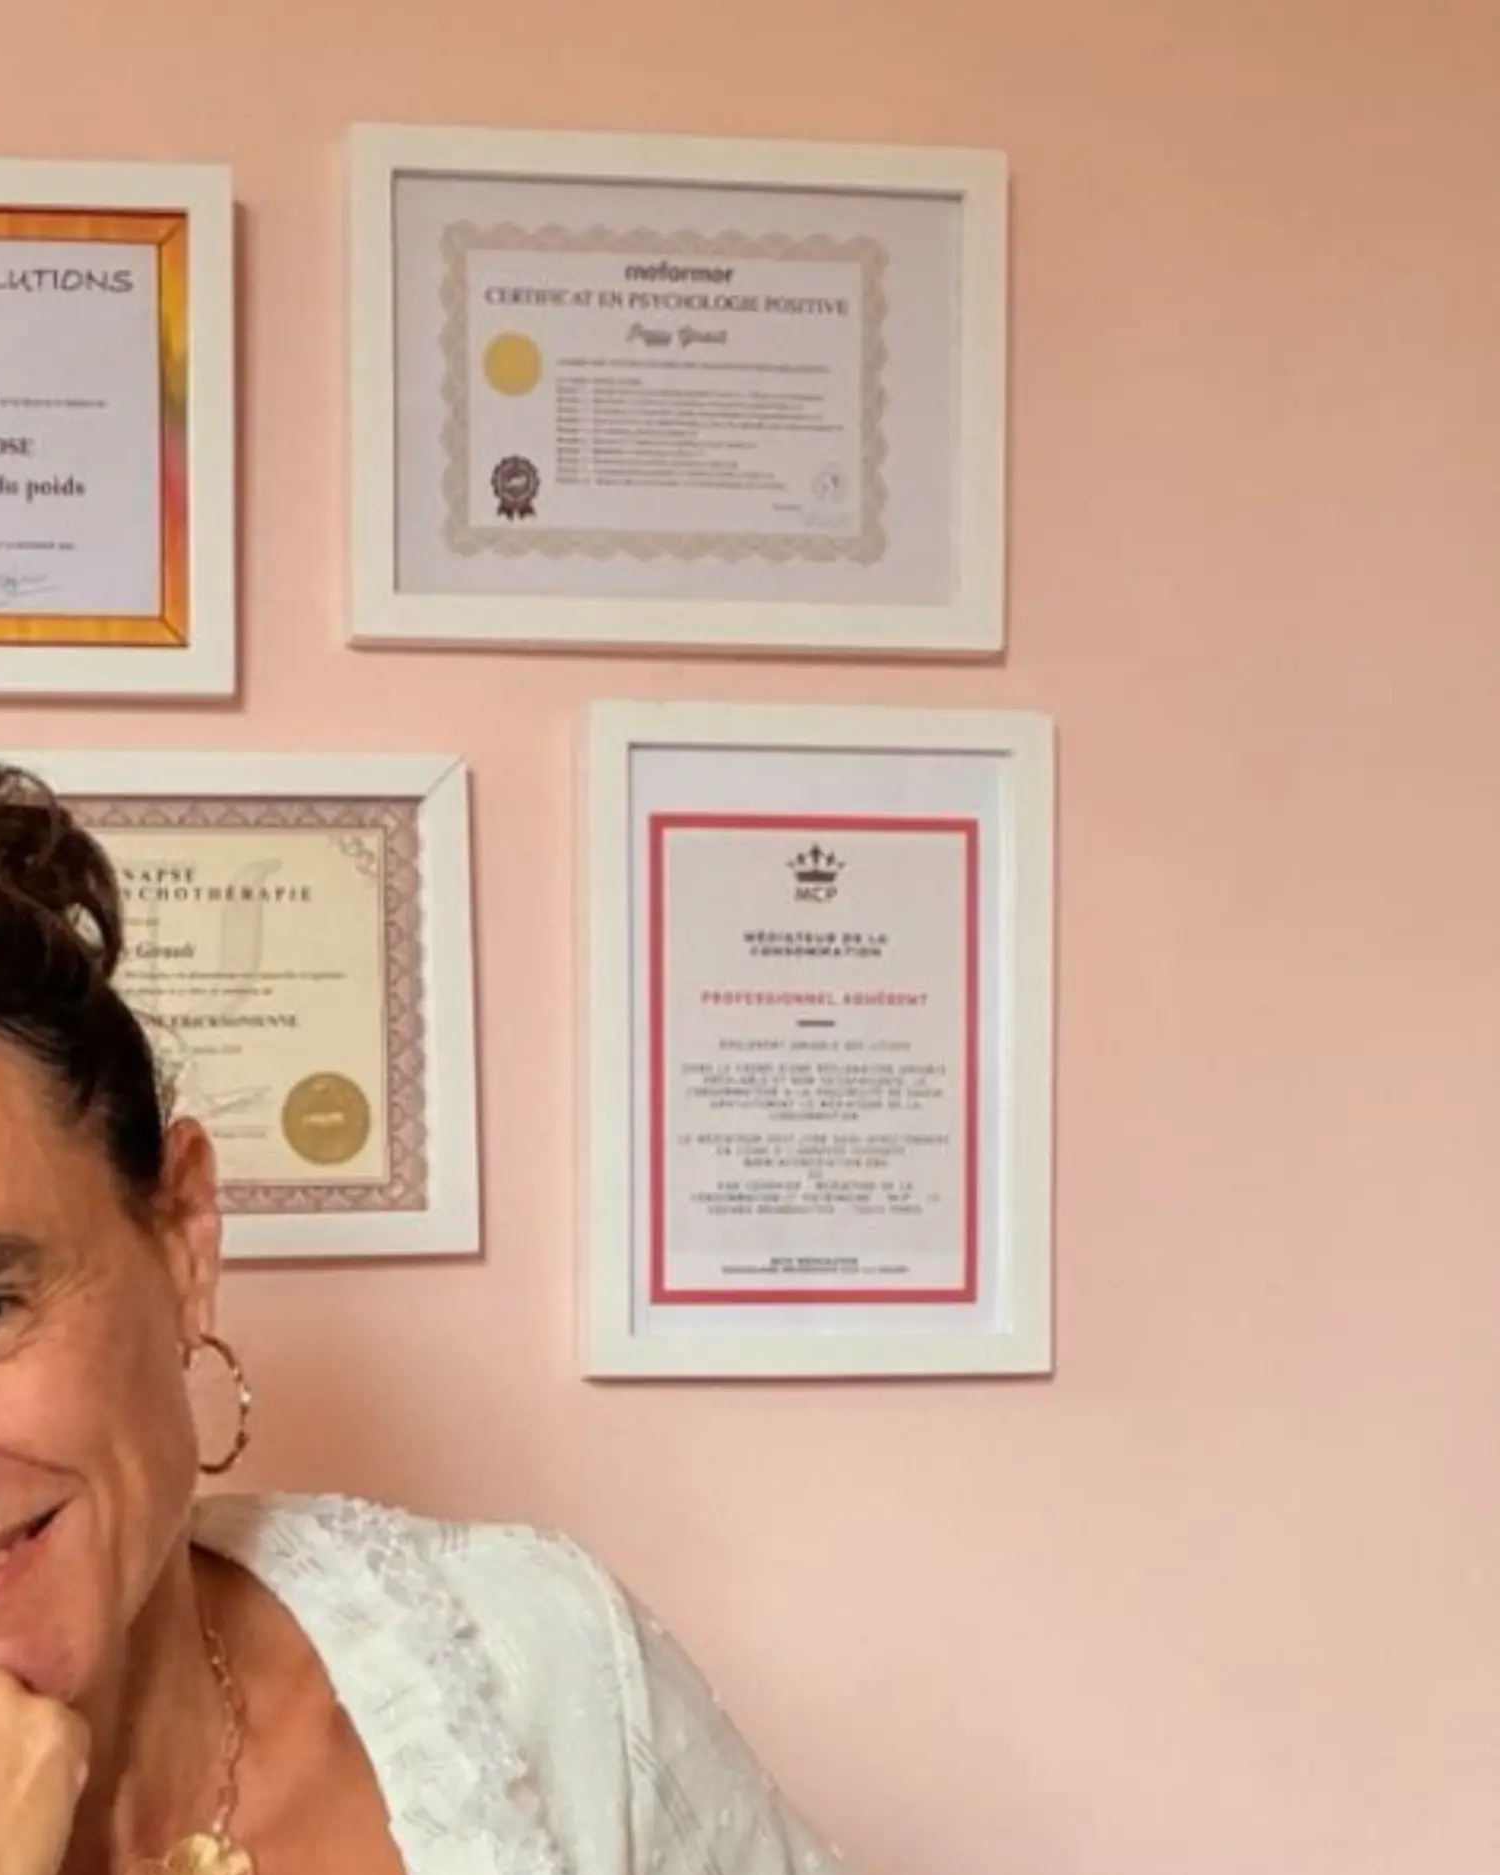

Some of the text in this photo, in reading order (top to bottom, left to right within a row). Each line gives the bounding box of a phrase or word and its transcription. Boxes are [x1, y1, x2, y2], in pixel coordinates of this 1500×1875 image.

[484, 286, 849, 316] CERTIFICAT EN PSYCHOLOGIE POSITIVE
[25, 474, 86, 501] poids
[794, 887, 838, 902] MCP
[701, 990, 837, 1006] PROFESSIONNEL
